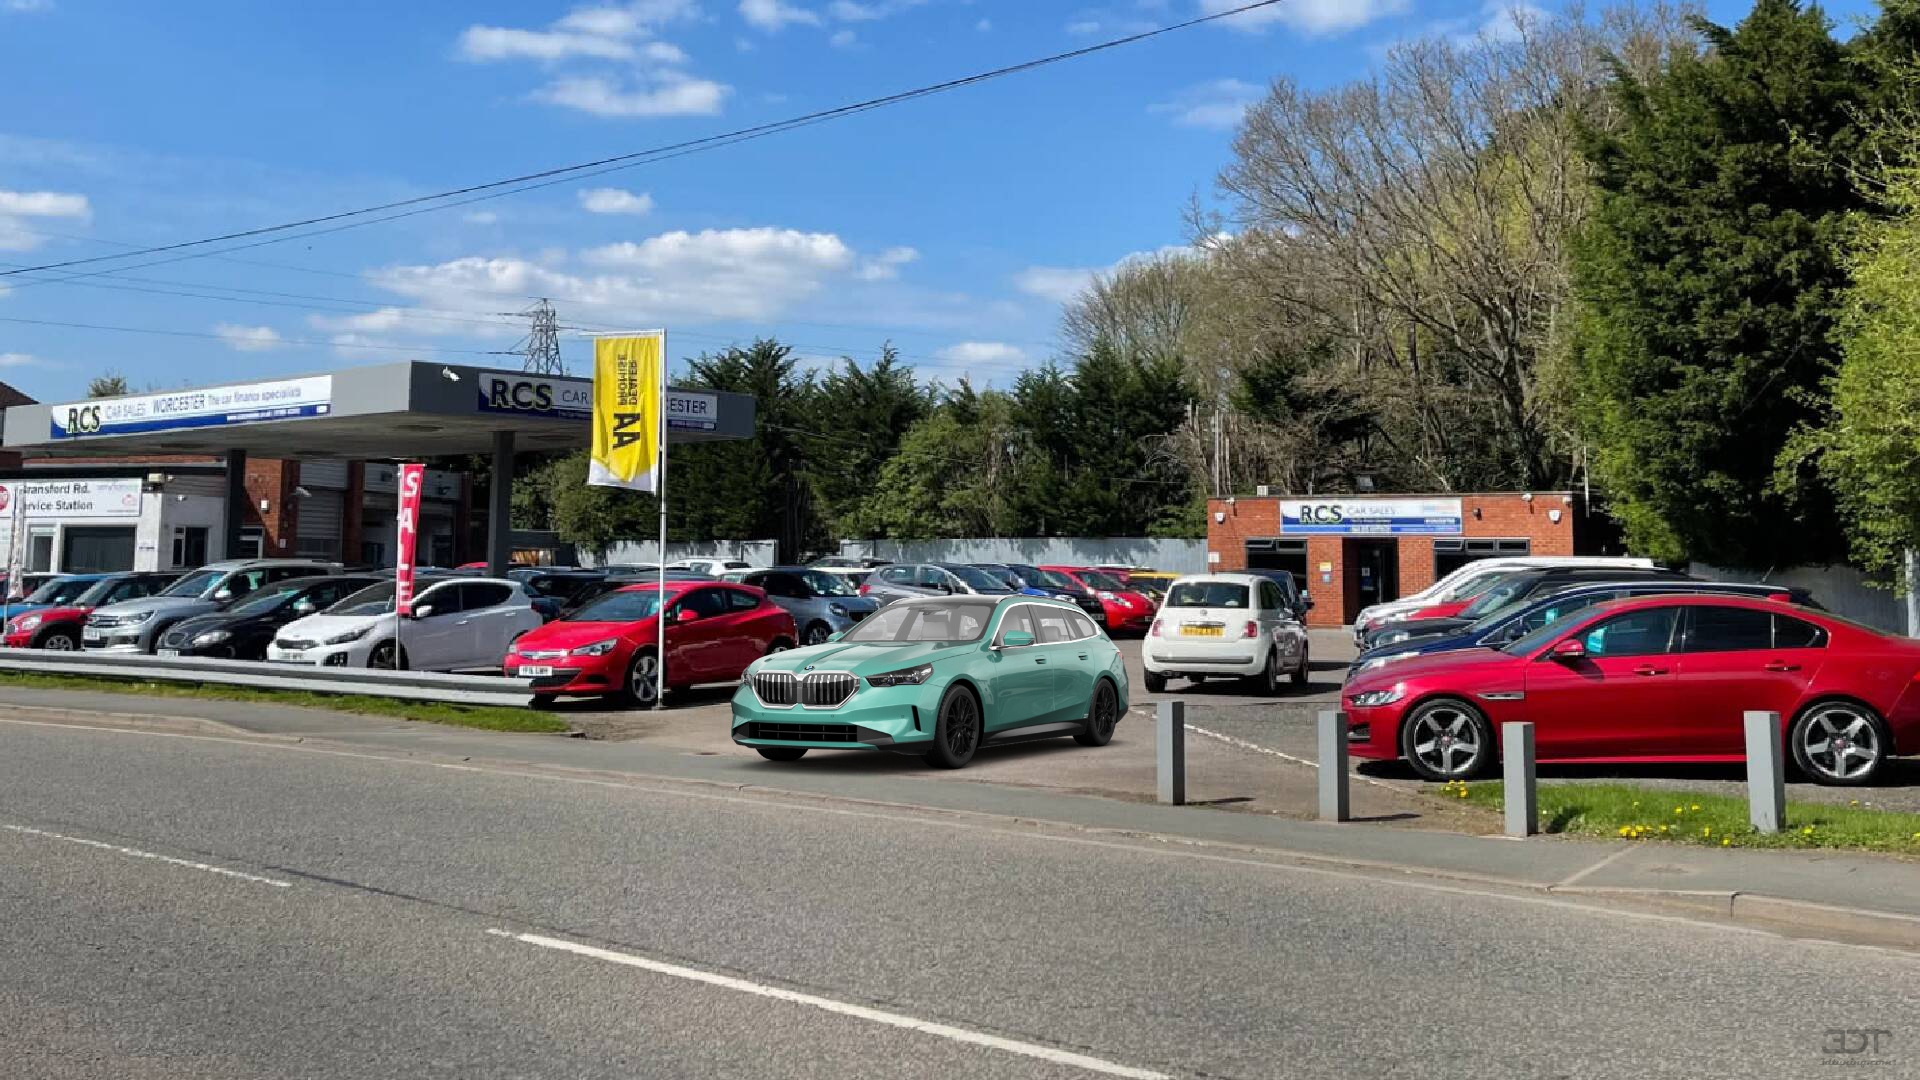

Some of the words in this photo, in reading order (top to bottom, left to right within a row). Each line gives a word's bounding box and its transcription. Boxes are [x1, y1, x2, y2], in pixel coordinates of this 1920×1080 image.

[490, 379, 553, 410] RCS
[562, 389, 589, 405] CAR
[67, 405, 101, 432] RCS
[153, 393, 205, 414] WORCESTER
[56, 499, 93, 510] Station
[1301, 504, 1343, 523] RCS
